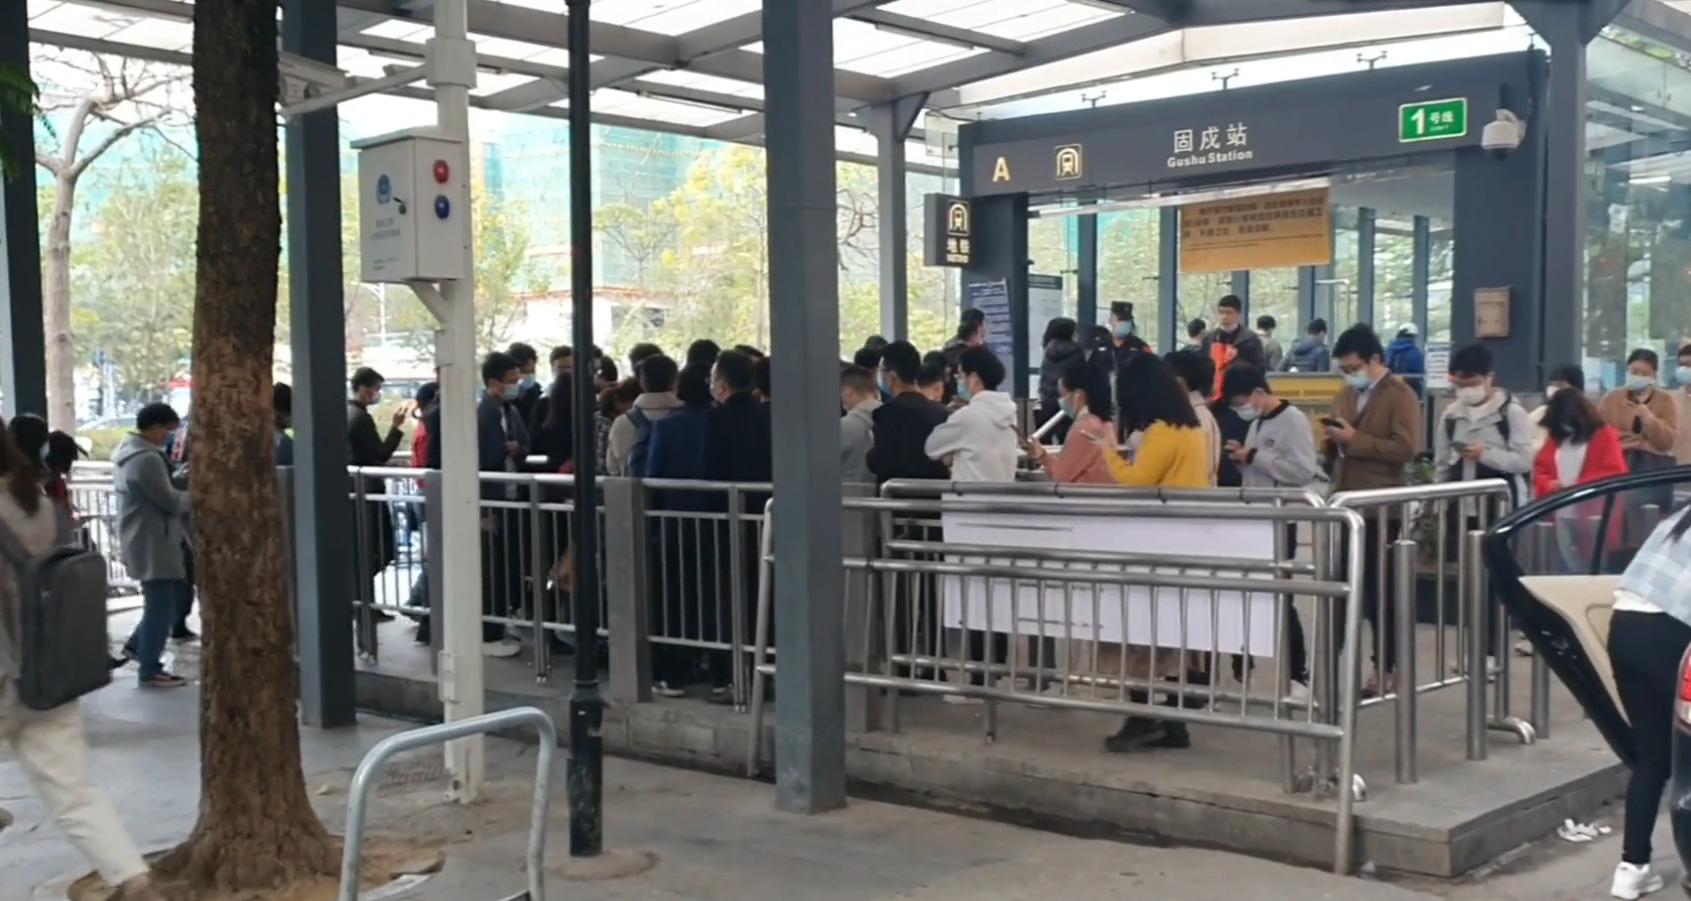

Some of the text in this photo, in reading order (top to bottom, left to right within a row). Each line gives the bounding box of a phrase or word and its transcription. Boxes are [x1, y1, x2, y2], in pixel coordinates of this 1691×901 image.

[1410, 107, 1425, 135] 1
[1173, 122, 1248, 153] 固戍站
[992, 156, 1011, 182] A
[1167, 149, 1254, 168] Gushu Station
